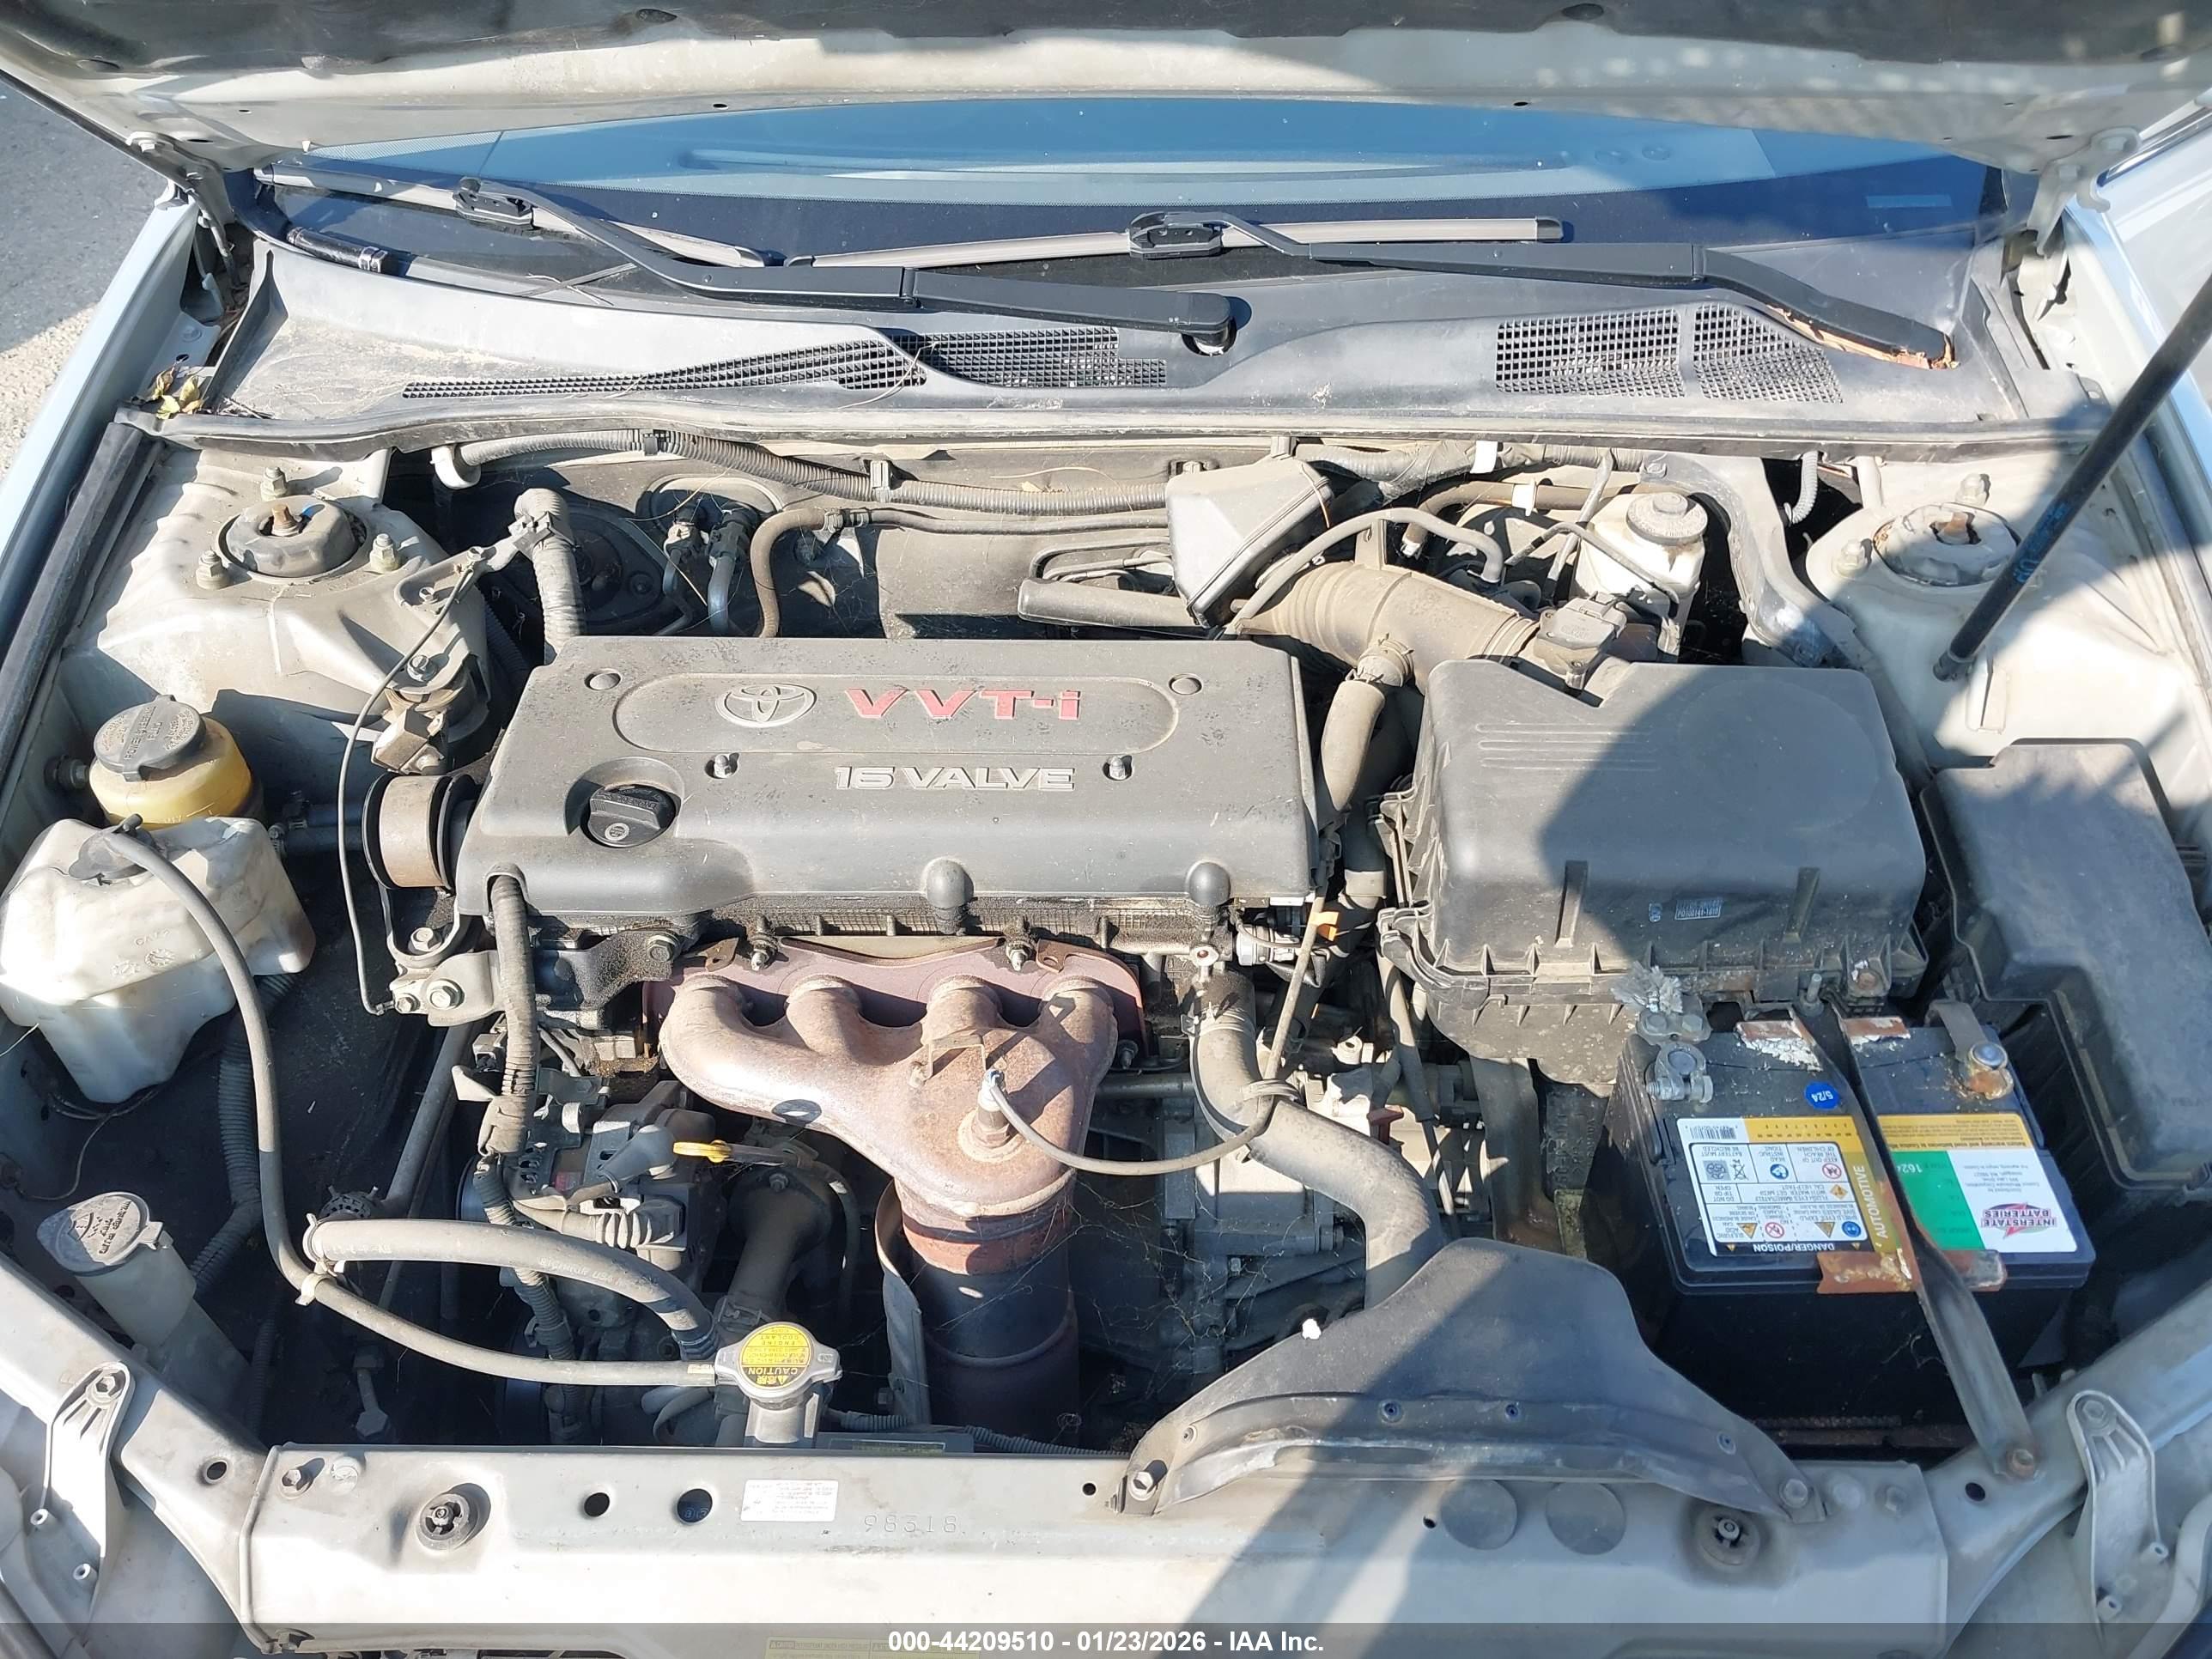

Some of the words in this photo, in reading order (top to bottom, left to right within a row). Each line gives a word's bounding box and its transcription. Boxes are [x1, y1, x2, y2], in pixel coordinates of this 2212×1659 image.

[846, 688, 1082, 720] VVT-i
[836, 766, 894, 791] 16
[901, 766, 1075, 791] VALVE
[1811, 1091, 1833, 1103] 5/24
[1853, 1165, 1888, 1239] AUTOMOTIVE
[1984, 1209, 2050, 1218] BATTERIES
[1984, 1218, 2056, 1228] INTERSTATE
[1753, 1243, 1835, 1252] DANGER/POISON
